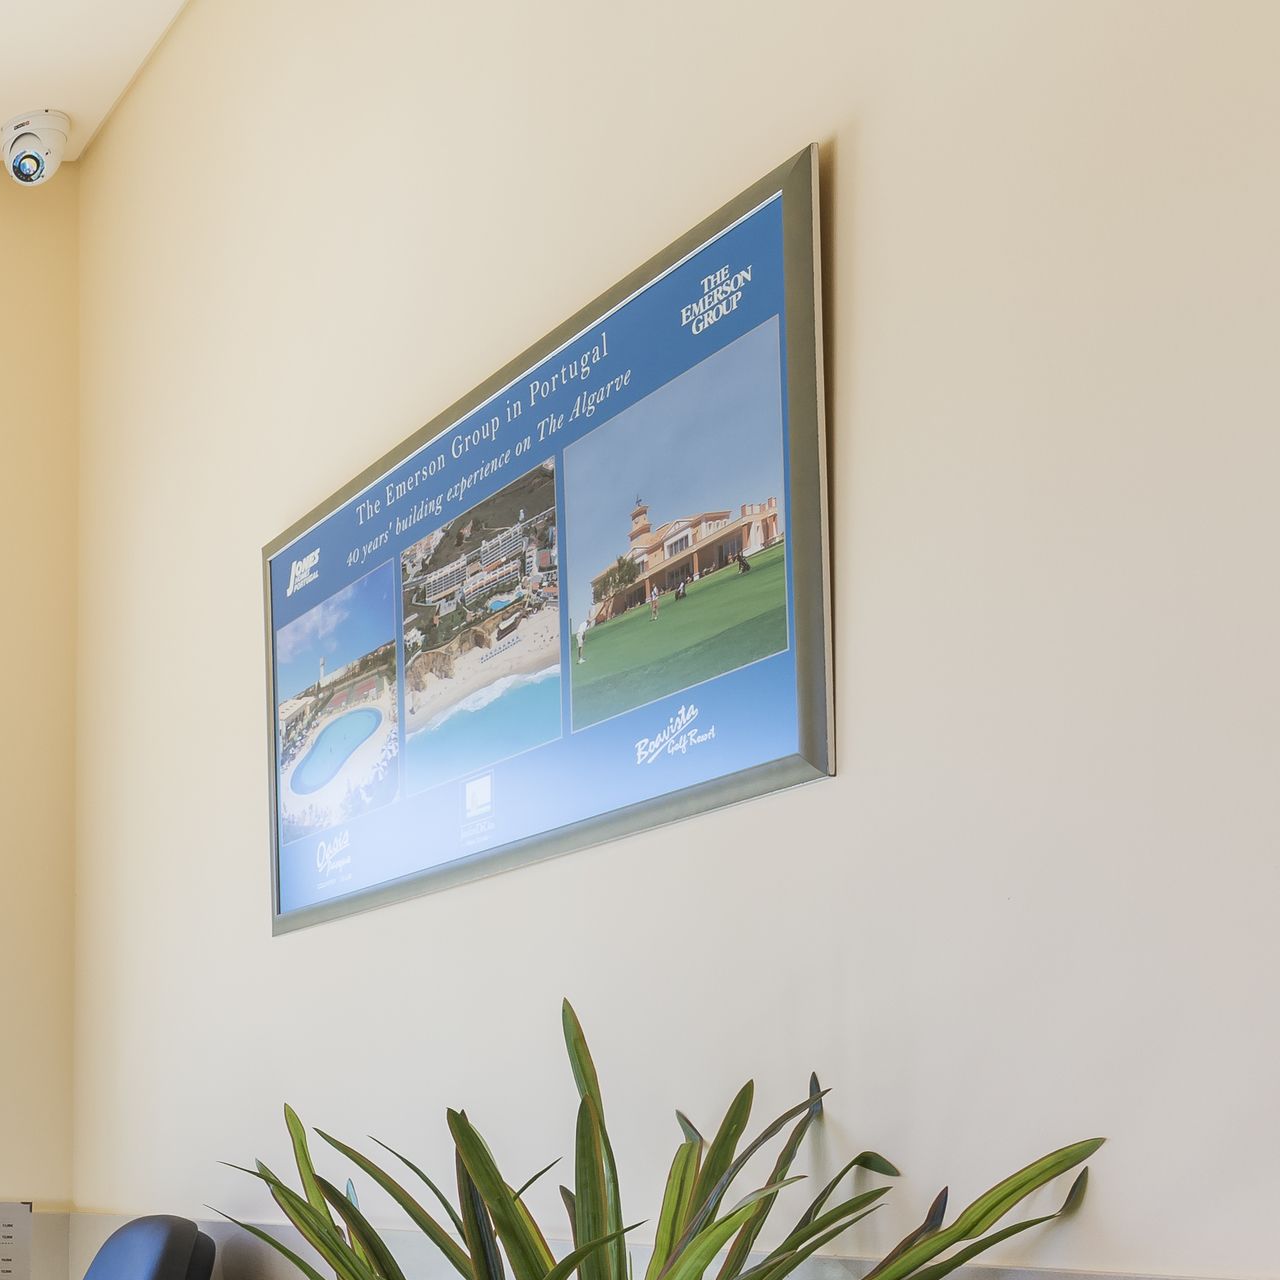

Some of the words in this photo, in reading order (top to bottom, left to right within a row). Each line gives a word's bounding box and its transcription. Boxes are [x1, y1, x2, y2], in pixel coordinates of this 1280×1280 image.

[680, 264, 753, 327] EMERSON
[700, 264, 730, 294] THE
[691, 291, 742, 335] GROUP
[355, 499, 381, 526] The
[385, 453, 446, 507] Emerson
[451, 416, 500, 459] Group
[506, 399, 522, 423] in
[529, 331, 609, 407] Portugal
[345, 547, 360, 567] 40
[361, 521, 393, 564] years'
[395, 493, 444, 536] building
[446, 448, 511, 502] experience
[515, 435, 531, 457] on
[536, 412, 565, 442] The
[568, 368, 632, 422] Algarve
[635, 704, 699, 765] Boavista
